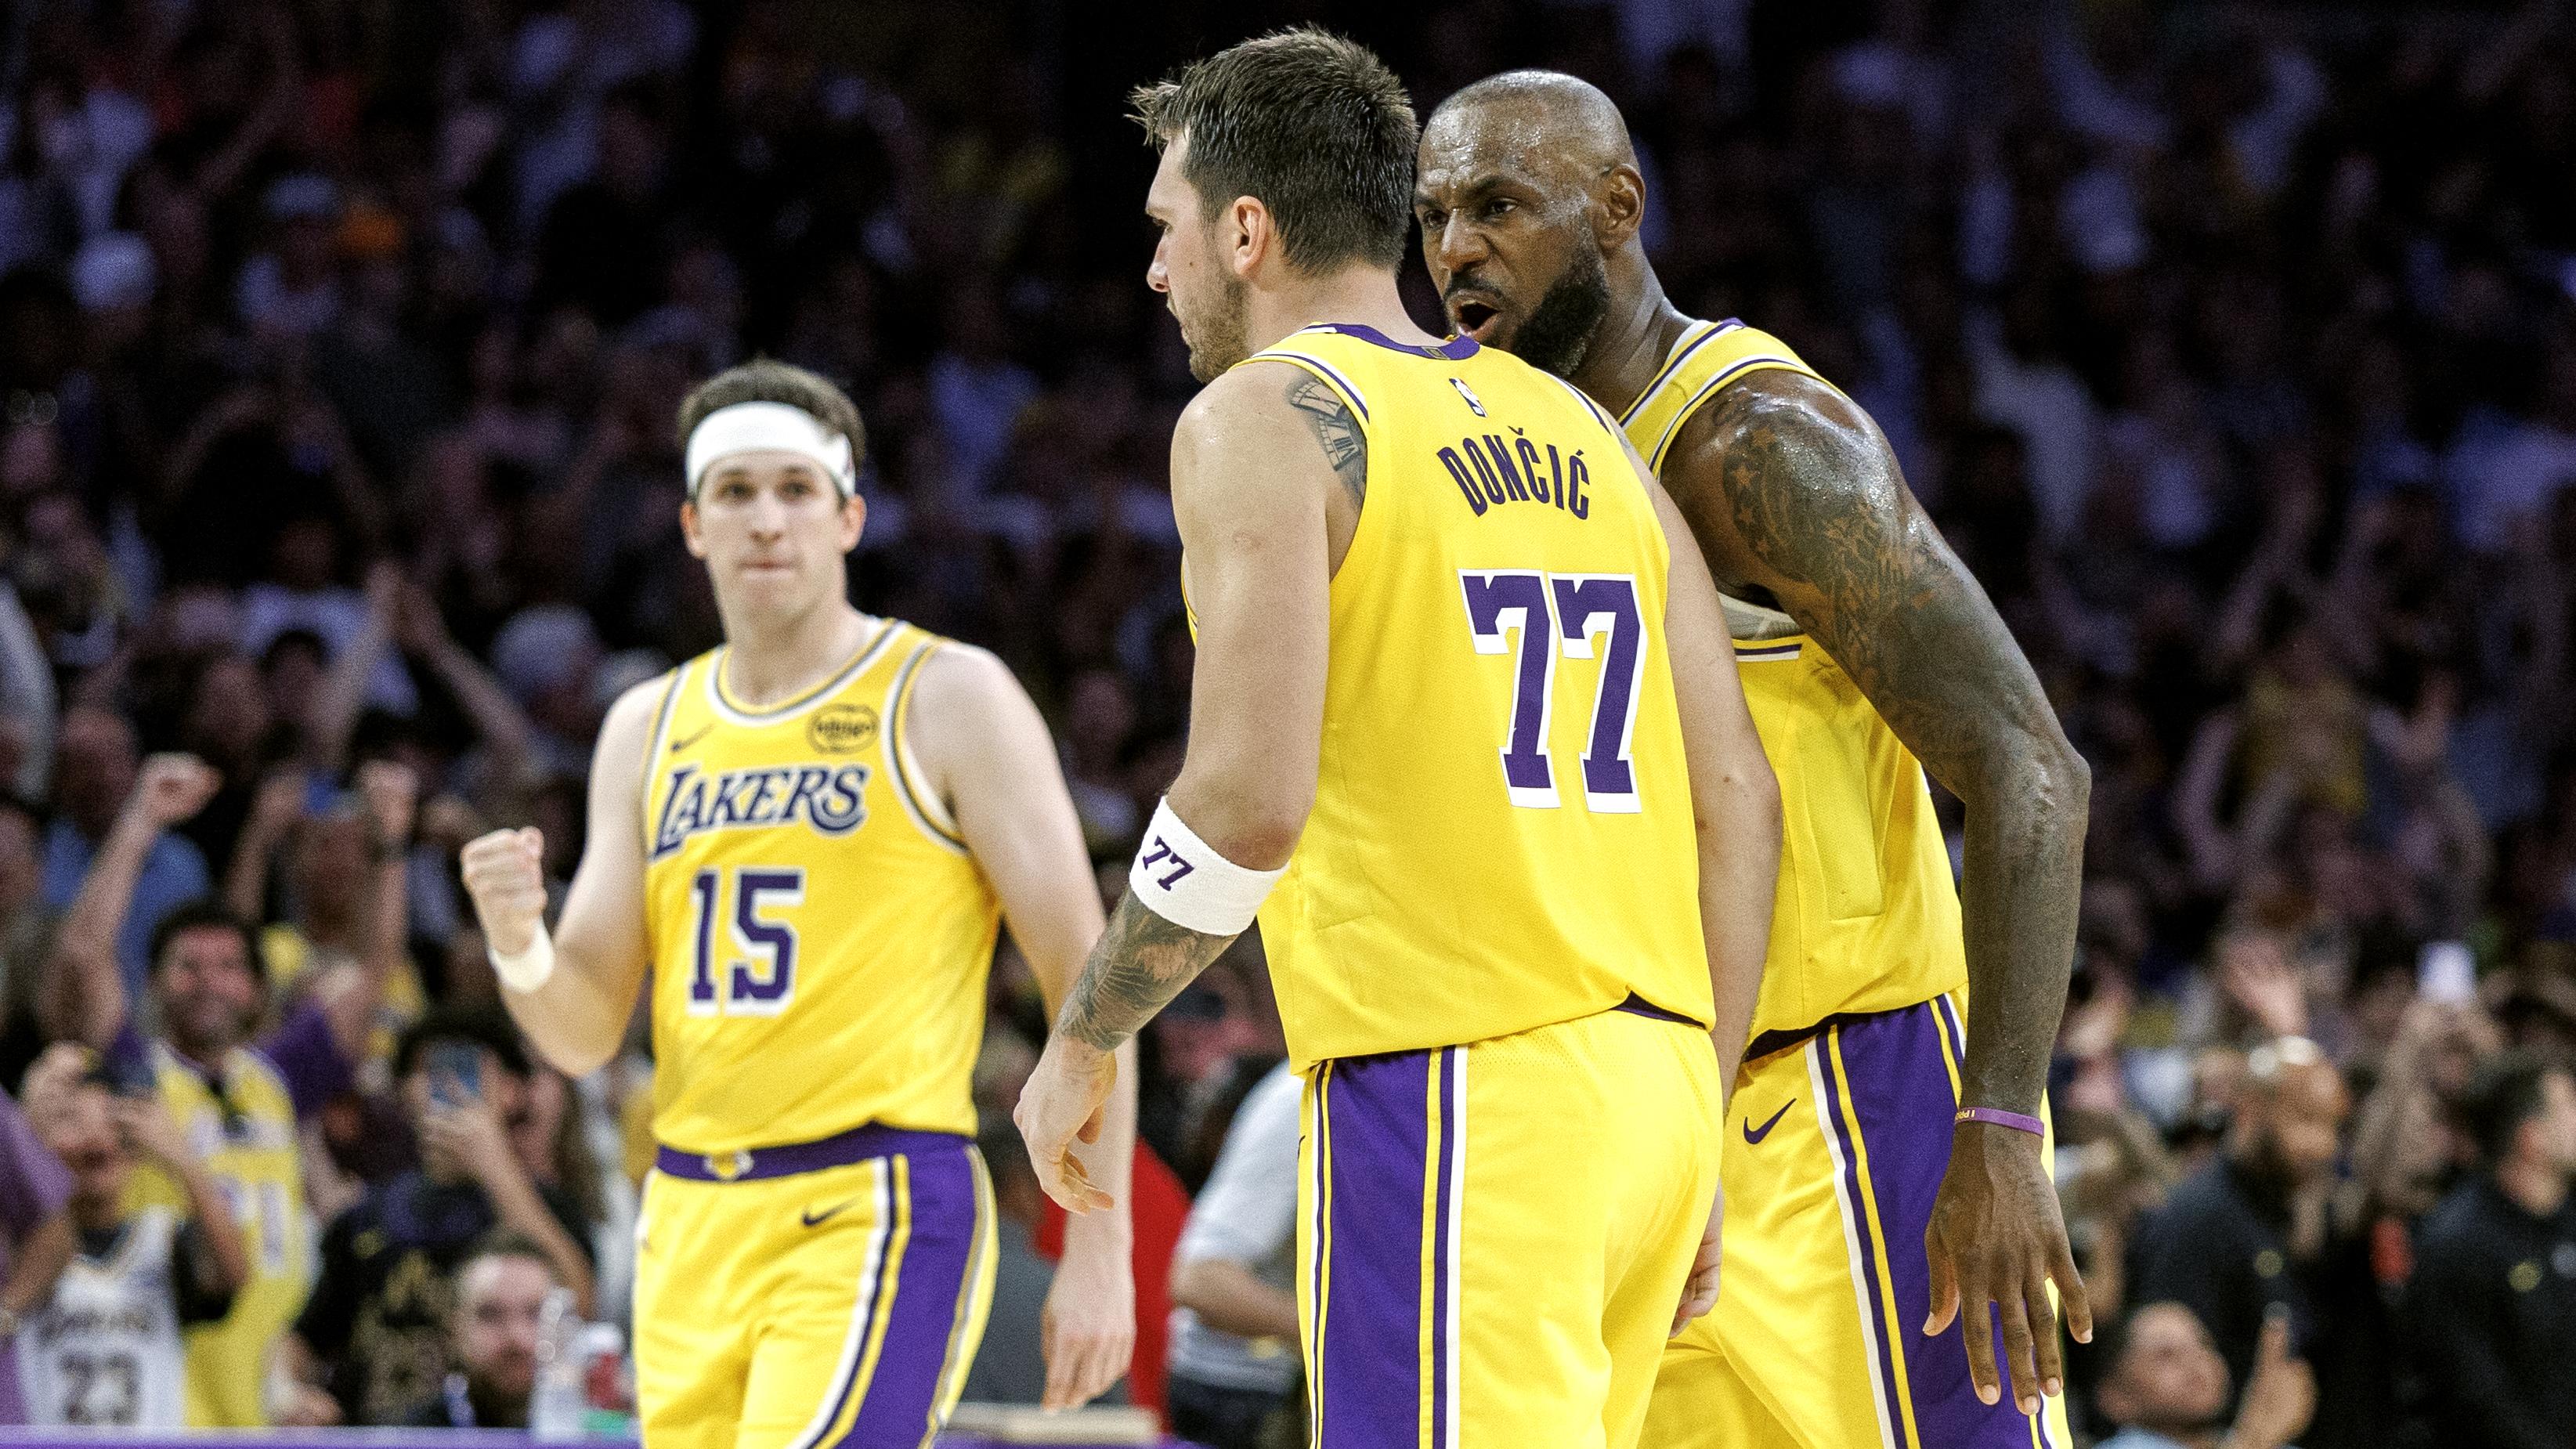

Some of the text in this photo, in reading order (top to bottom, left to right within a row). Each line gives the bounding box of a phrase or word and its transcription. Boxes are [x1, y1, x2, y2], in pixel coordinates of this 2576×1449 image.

[1436, 424, 1591, 520] DONČIĆ
[1457, 568, 1648, 814] 77
[650, 763, 869, 860] LAKERS
[1142, 835, 1194, 891] 77
[687, 866, 805, 1017] 15
